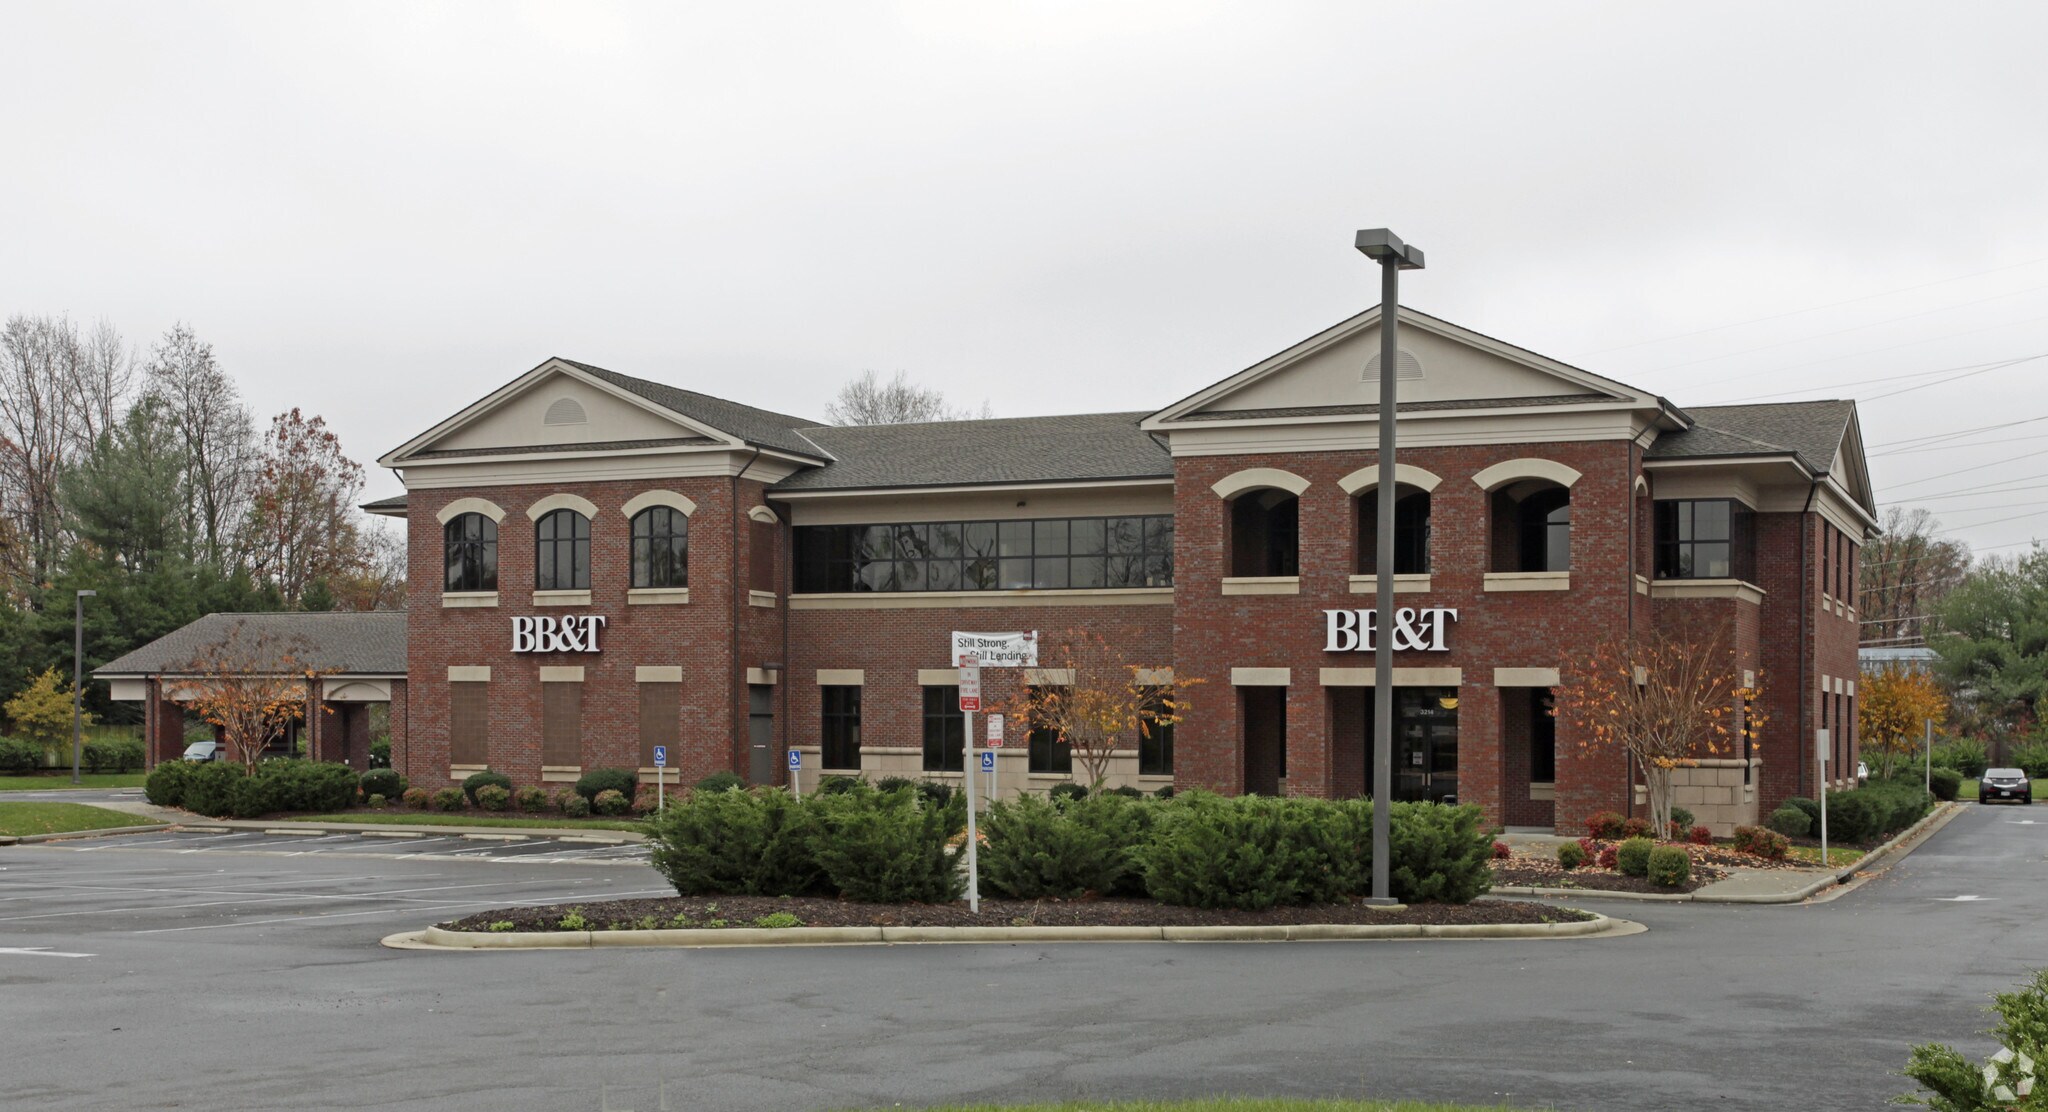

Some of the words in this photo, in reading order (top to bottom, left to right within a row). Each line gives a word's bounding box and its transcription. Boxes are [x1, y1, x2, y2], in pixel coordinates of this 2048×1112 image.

[510, 615, 605, 652] BB&T
[957, 638, 975, 648] Still
[977, 638, 1010, 650] Strong.
[1323, 607, 1457, 651] BB&T
